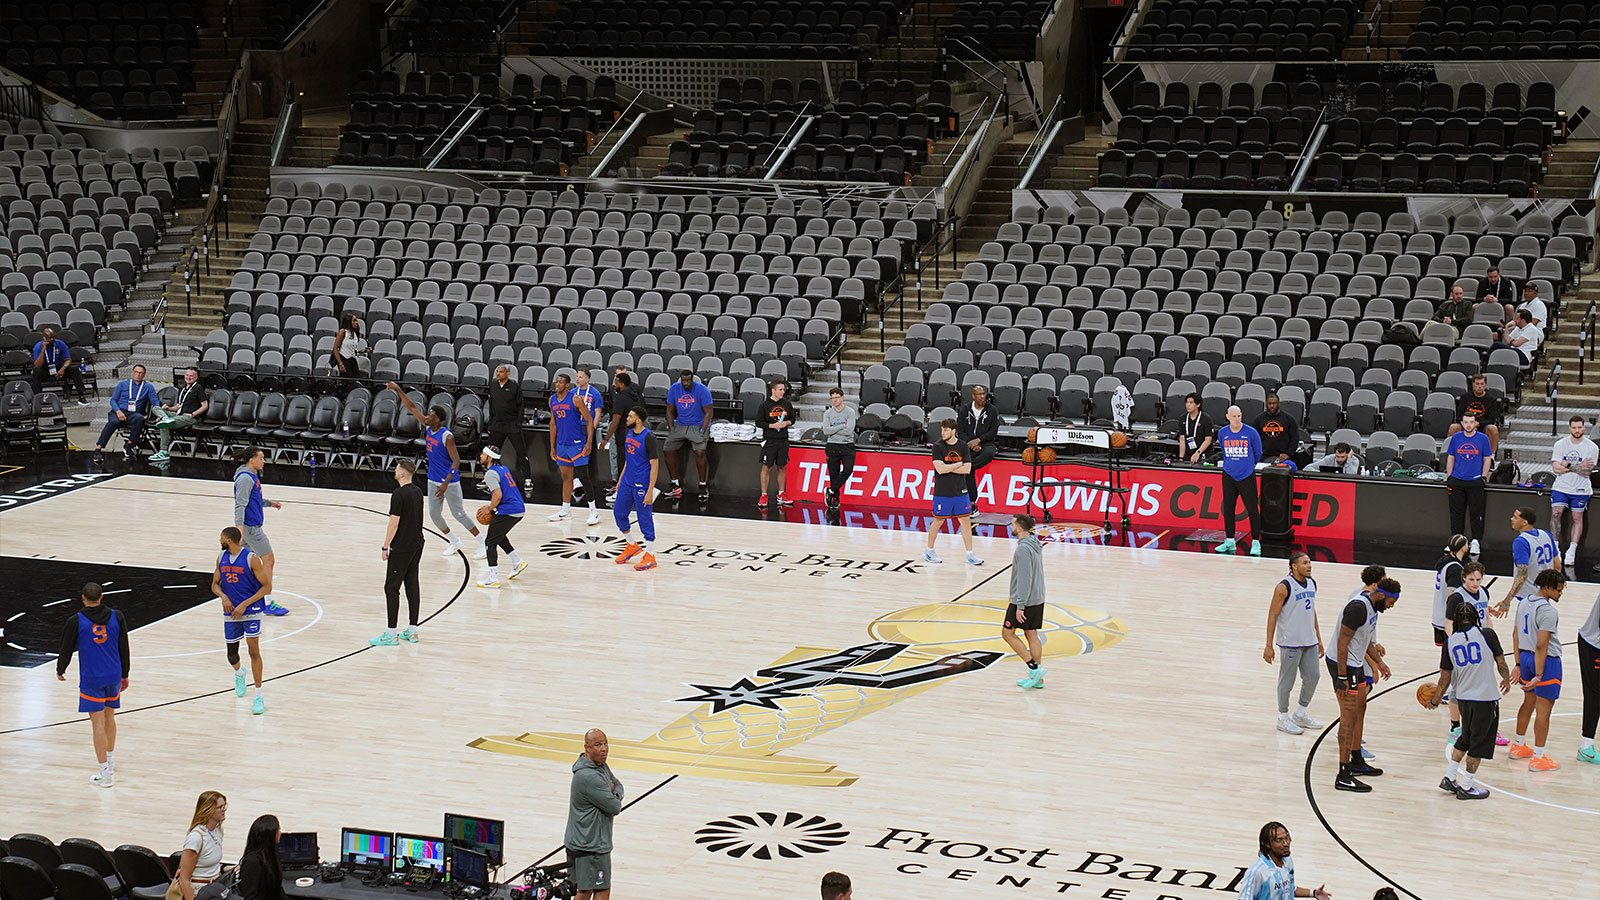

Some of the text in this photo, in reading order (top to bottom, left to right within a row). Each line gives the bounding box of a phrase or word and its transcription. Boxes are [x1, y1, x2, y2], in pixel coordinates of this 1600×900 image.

[1283, 202, 1294, 220] 8
[556, 410, 566, 418] 50
[1067, 431, 1094, 440] Wilson
[1224, 439, 1249, 447] ALWAYS
[626, 444, 635, 455] 32
[504, 471, 517, 487] 11
[871, 466, 996, 505] AREA
[1005, 474, 1118, 513] BOWL
[1127, 482, 1163, 516] IS
[1169, 484, 1340, 528] CLED
[657, 543, 928, 575] Frost Bank
[1535, 543, 1553, 565] 20
[225, 573, 239, 583] 25
[674, 559, 864, 580] CENTER
[1305, 599, 1311, 610] 2
[92, 623, 107, 644] 9
[1522, 613, 1530, 635] 1
[1452, 641, 1482, 667] 00
[864, 827, 1060, 869] Frost
